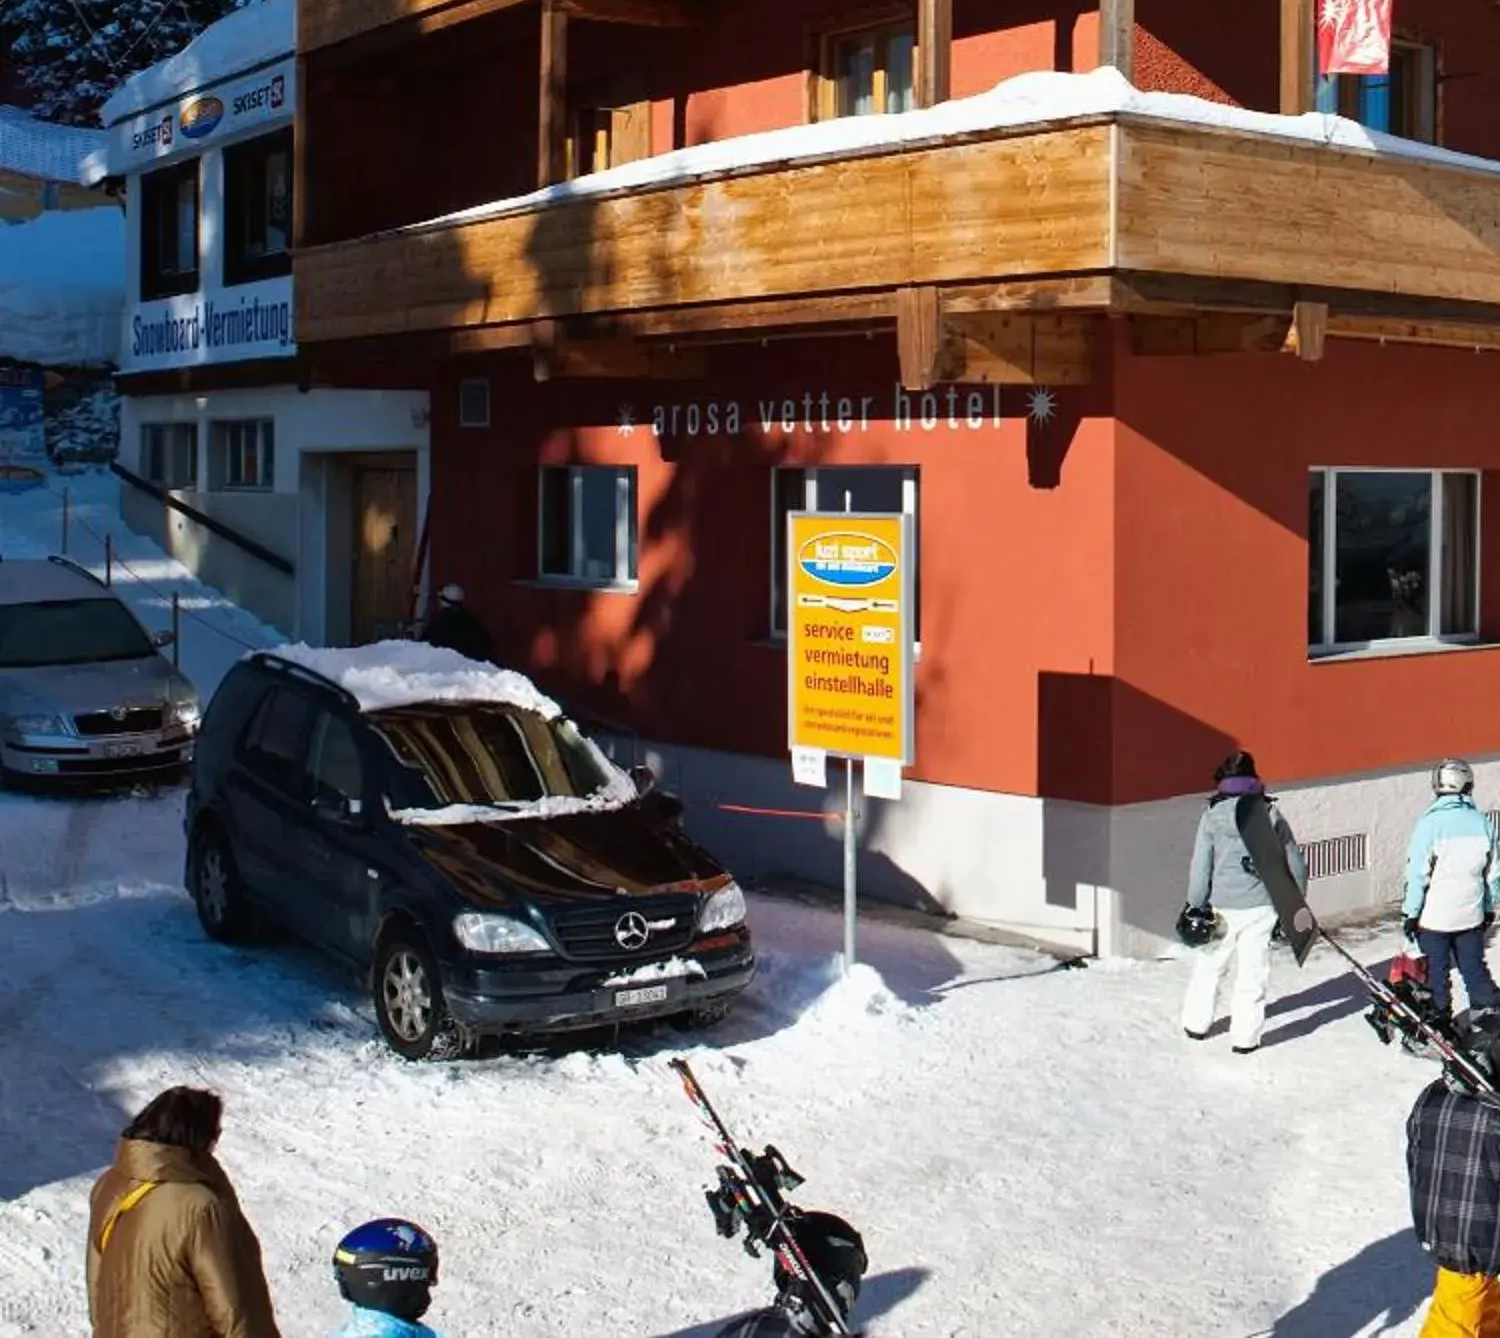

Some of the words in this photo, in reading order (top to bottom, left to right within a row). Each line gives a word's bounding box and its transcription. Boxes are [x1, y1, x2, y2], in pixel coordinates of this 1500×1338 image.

[233, 85, 270, 116] SKISET
[132, 296, 289, 357] Snowboard-Vermietung
[652, 398, 740, 437] arosa
[758, 392, 873, 434] vetter
[895, 380, 1001, 431] hotel
[805, 621, 854, 641] service
[805, 647, 890, 675] vermietung
[805, 671, 894, 699] einstellhalle
